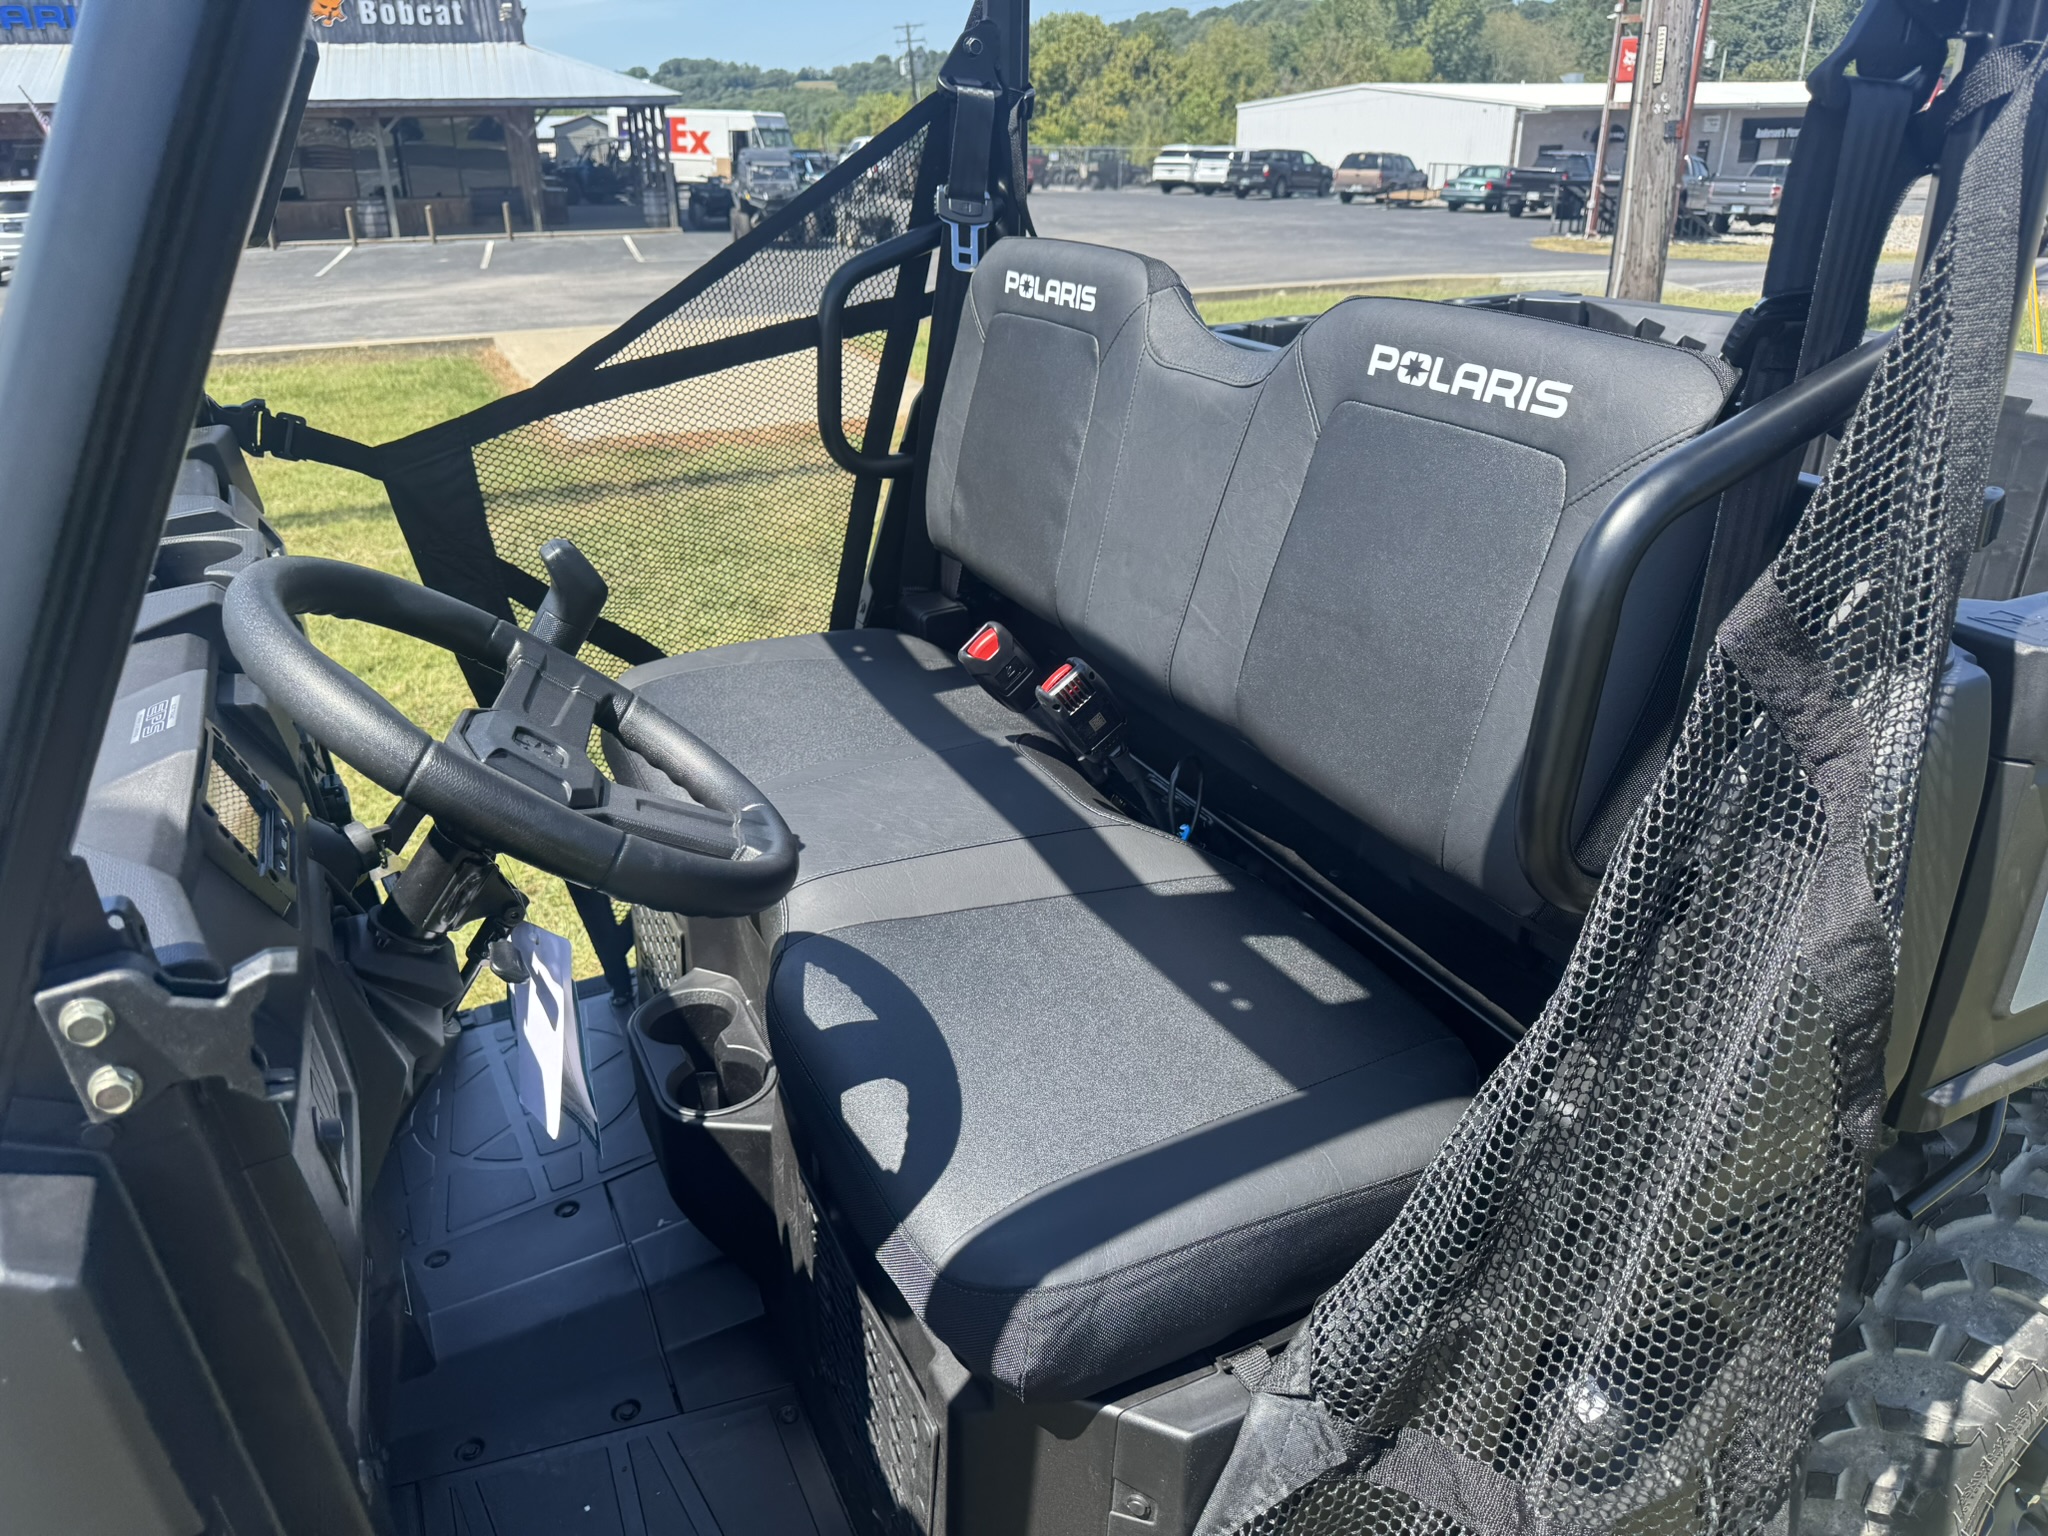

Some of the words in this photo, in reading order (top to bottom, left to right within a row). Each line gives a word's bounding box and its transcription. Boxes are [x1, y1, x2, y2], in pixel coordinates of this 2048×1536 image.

[358, 0, 464, 26] Bobcat
[1005, 270, 1097, 312] POLARIS
[1367, 344, 1573, 419] POLARIS
[142, 699, 169, 738] EPS
